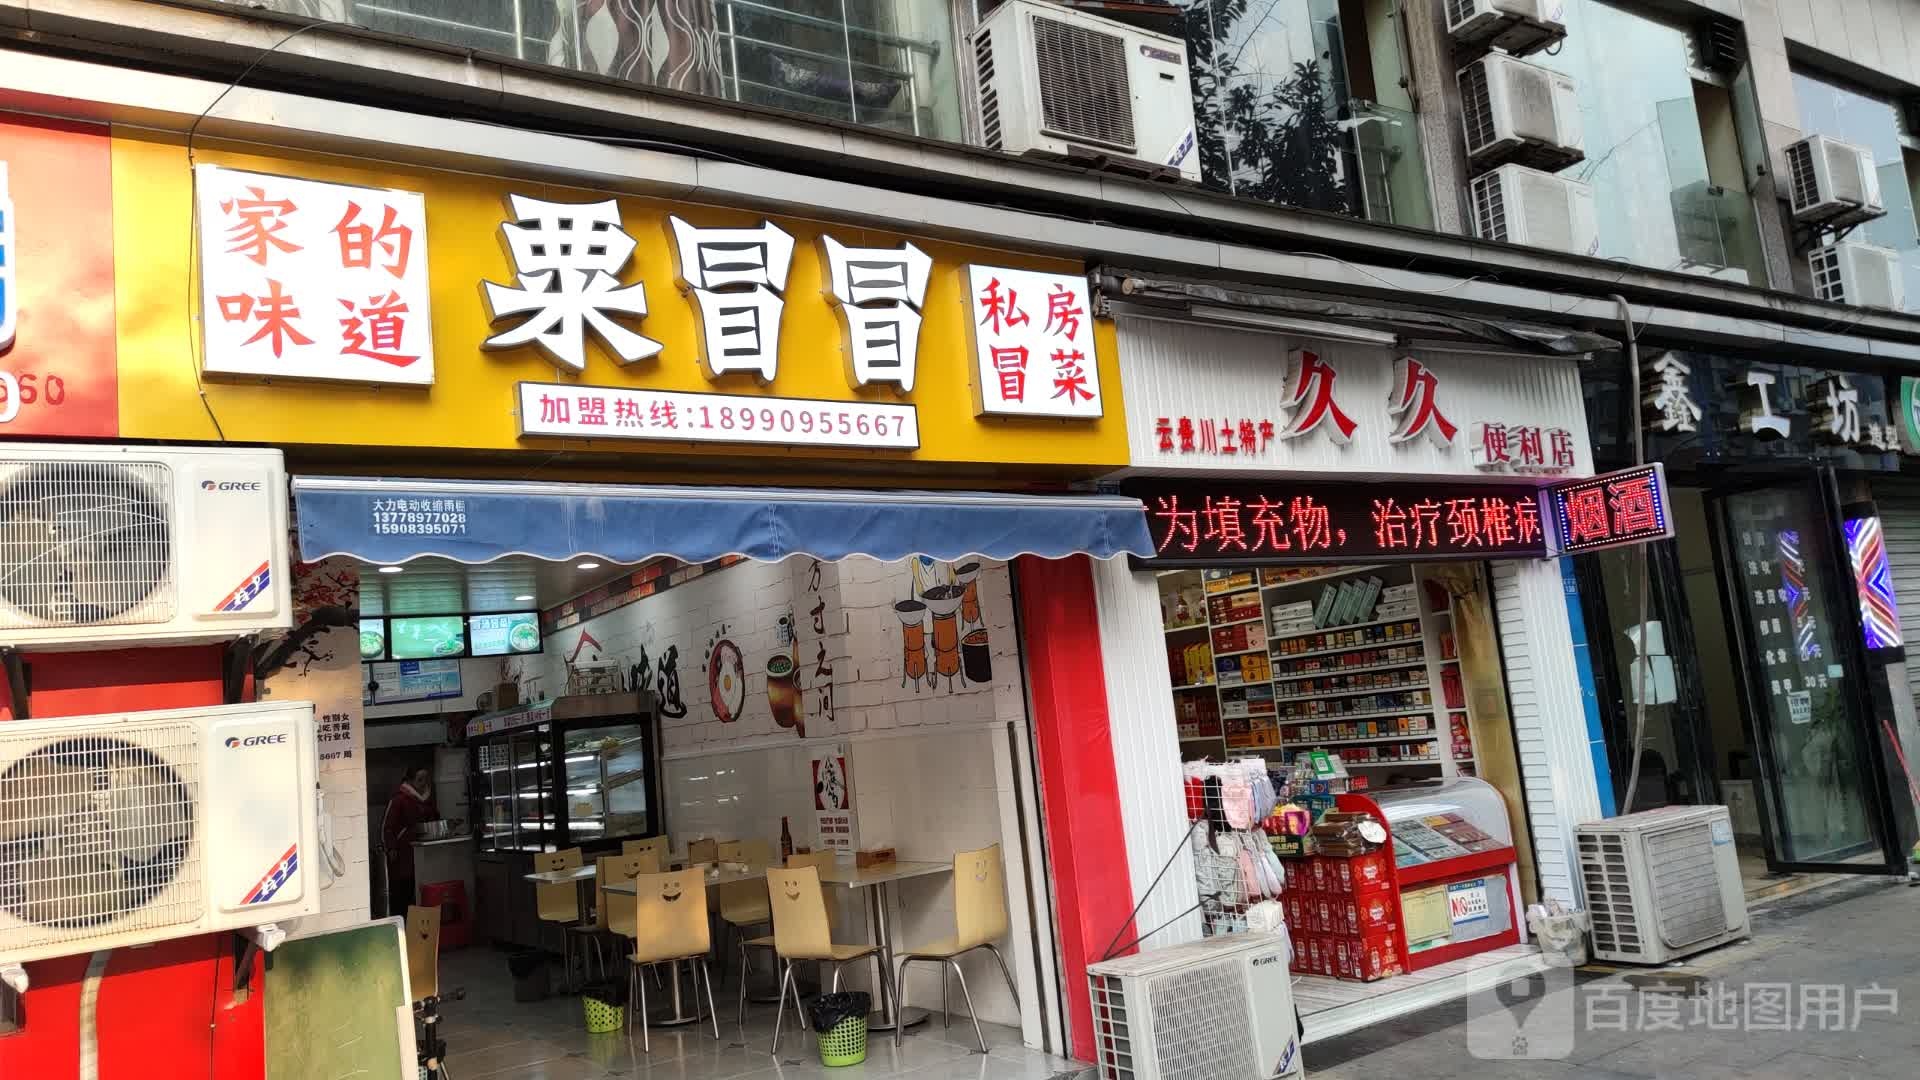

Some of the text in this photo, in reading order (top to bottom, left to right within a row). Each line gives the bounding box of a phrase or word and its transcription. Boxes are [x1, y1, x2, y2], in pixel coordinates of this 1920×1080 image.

[219, 186, 414, 280] 家的
[482, 192, 934, 392] 粟冒冒
[979, 277, 1083, 343] 私房
[218, 281, 421, 368] 味道
[988, 343, 1095, 407] 冒菜
[1281, 347, 1459, 449] 久久
[1652, 350, 1861, 443] 鑫工坊
[539, 393, 907, 439] 加盟热线:18990955667
[1155, 416, 1275, 456] 云贵川土特产
[1482, 422, 1575, 467] 便利店
[218, 481, 262, 491] GREE
[1565, 477, 1656, 543] 烟酒
[373, 512, 466, 523] 13778977028
[373, 523, 466, 535] 15908395071
[1144, 495, 1542, 553] 为填充物，治疗颈椎病
[243, 733, 288, 747] GREE
